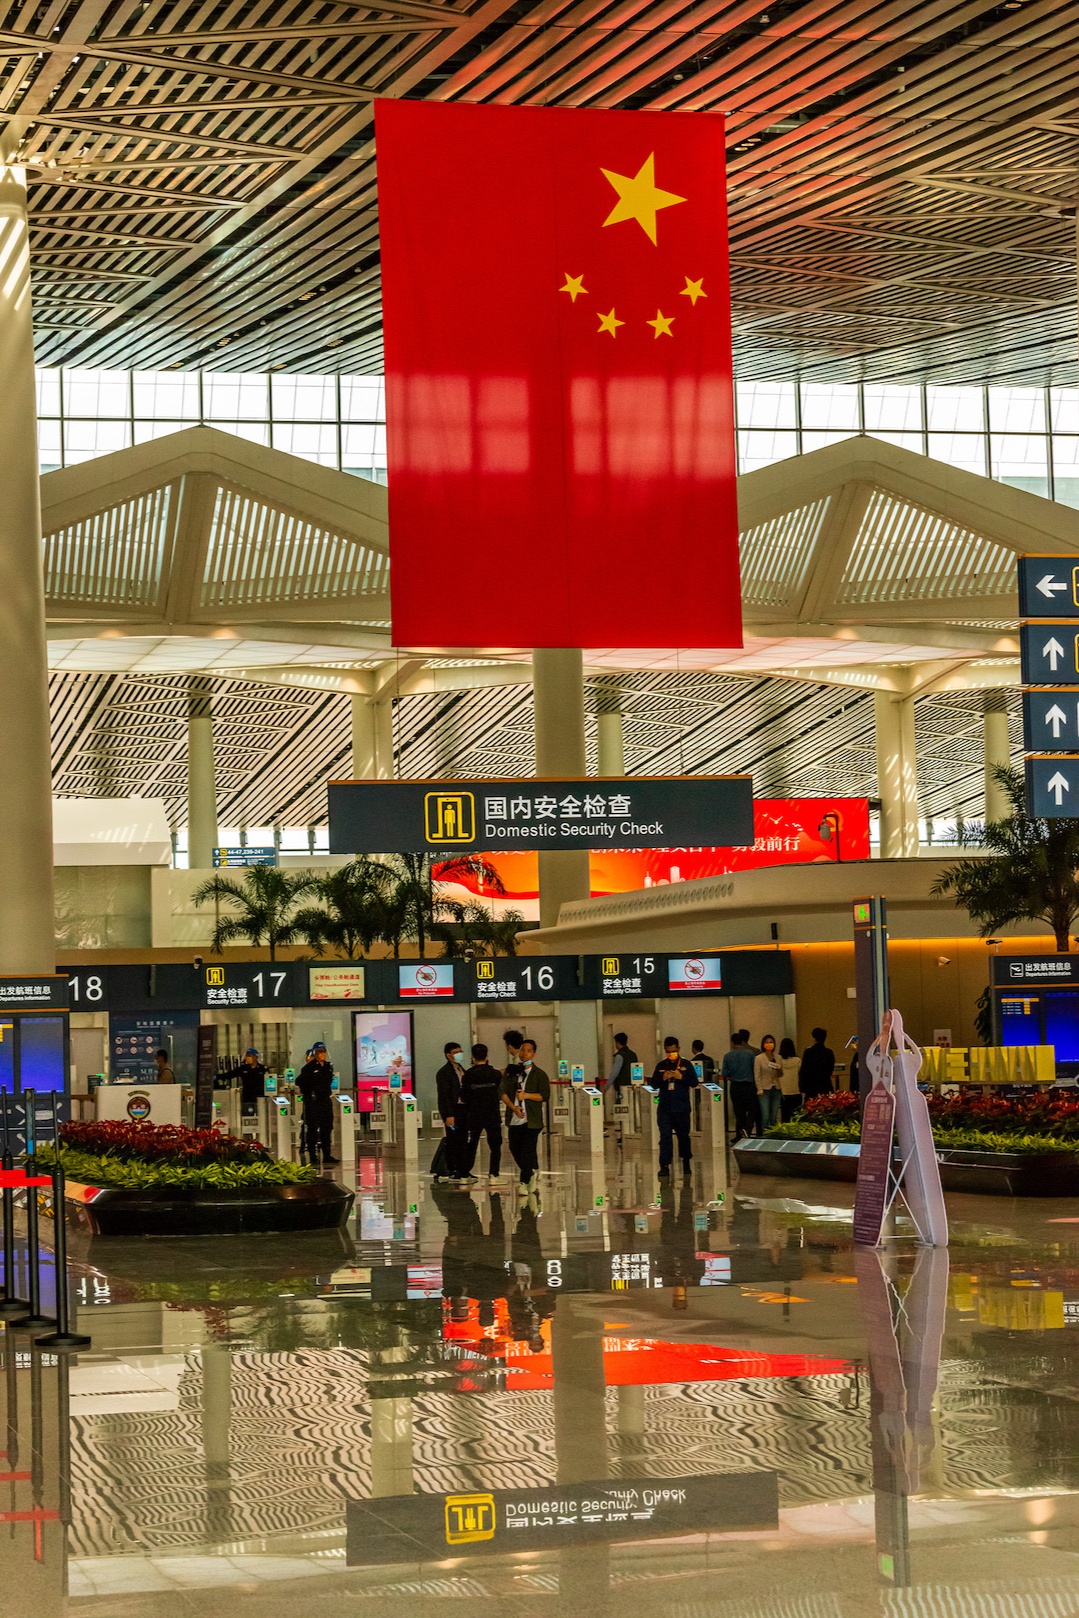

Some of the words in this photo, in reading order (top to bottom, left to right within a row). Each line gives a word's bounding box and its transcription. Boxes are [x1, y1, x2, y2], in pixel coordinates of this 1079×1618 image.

[484, 794, 632, 820] 国内安全检查
[485, 824, 557, 838] Domestic
[560, 822, 616, 838] Security
[620, 821, 664, 835] Check
[633, 957, 655, 974] 15
[252, 972, 287, 998] 17
[521, 965, 554, 991] 16
[603, 978, 642, 989] 安全检查
[68, 976, 103, 1001] 18
[207, 988, 248, 999] 安全检查
[477, 981, 517, 993] 安全检查
